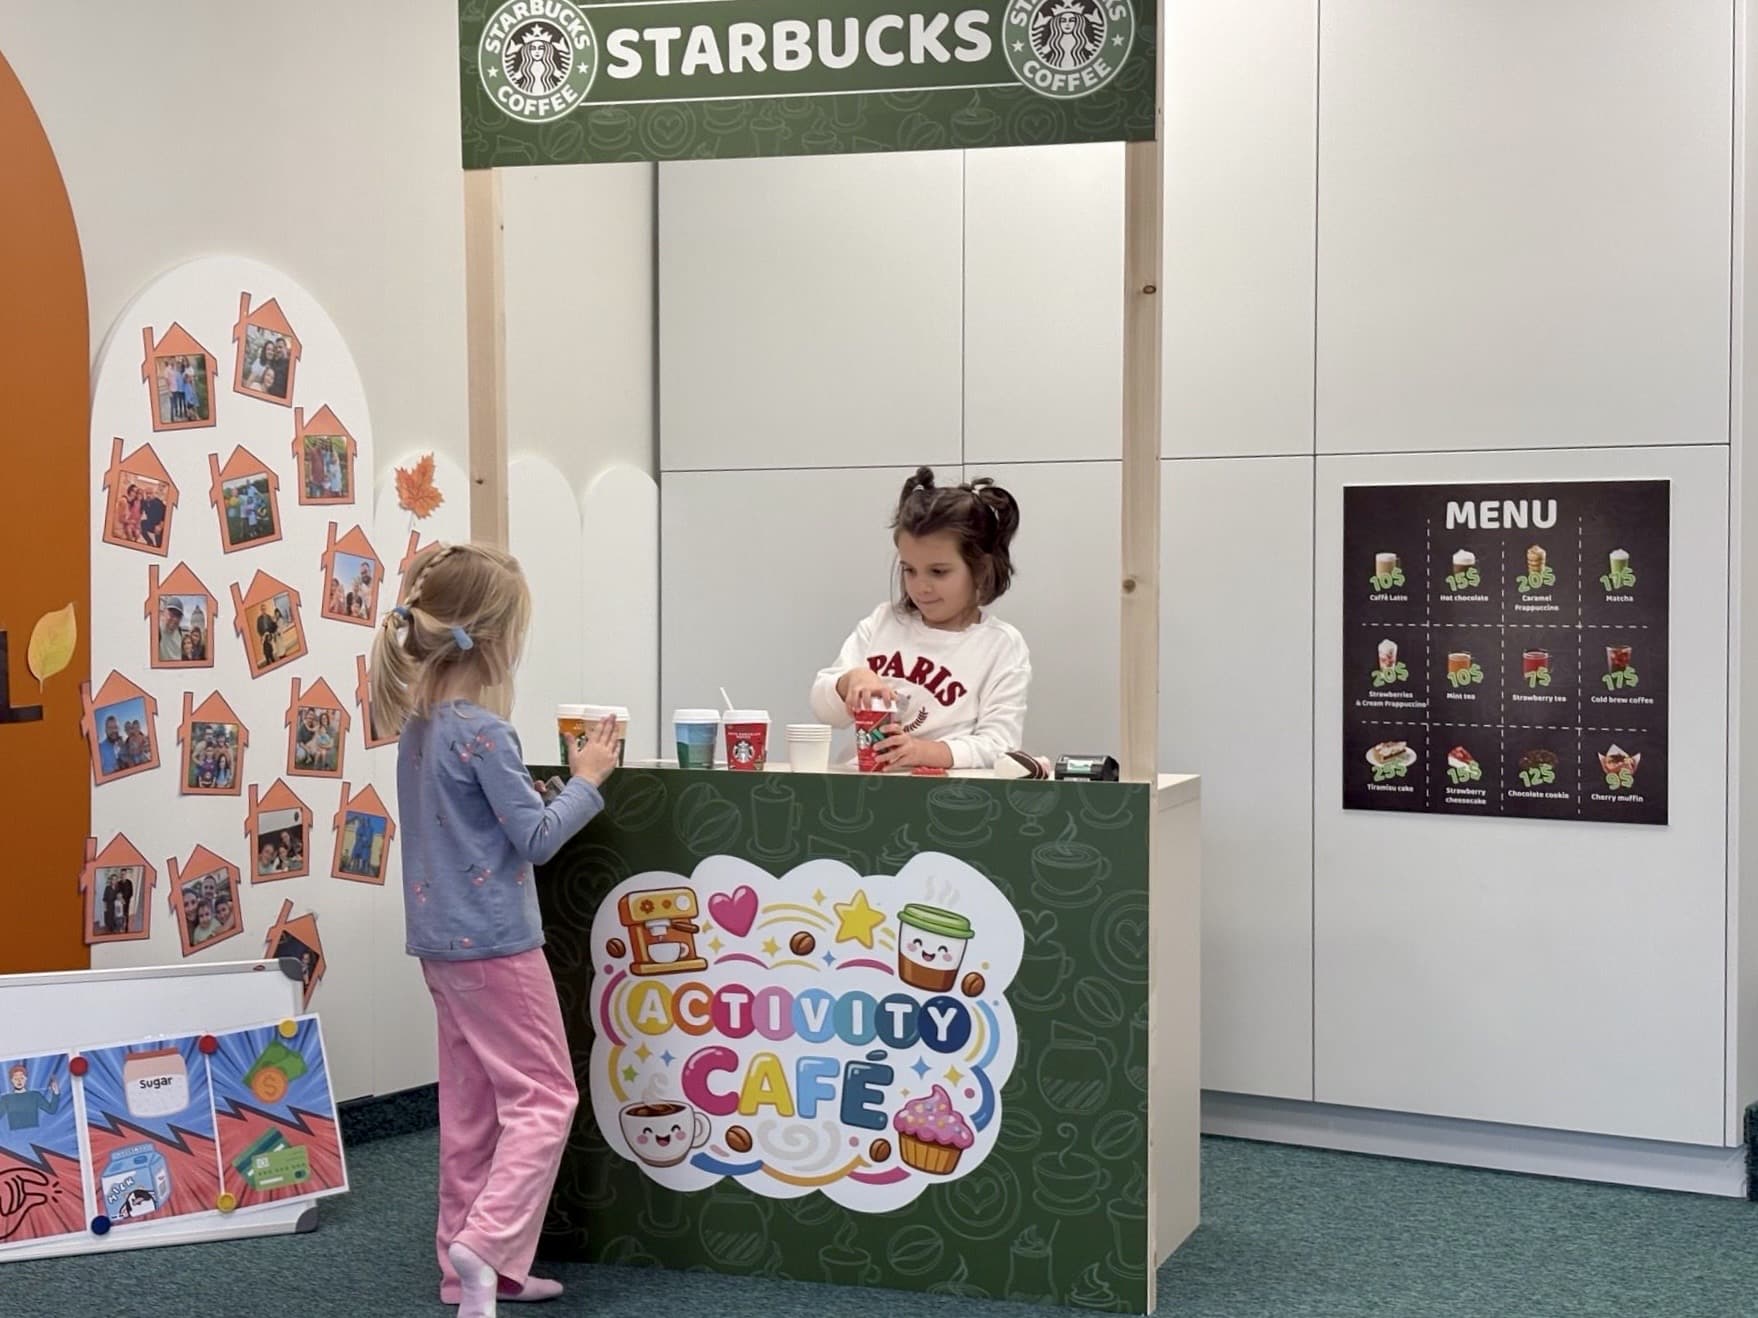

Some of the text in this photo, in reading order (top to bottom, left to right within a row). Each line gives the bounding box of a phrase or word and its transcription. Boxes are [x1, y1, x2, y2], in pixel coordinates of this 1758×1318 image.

[485, 0, 591, 54] STARBUCKS
[606, 10, 993, 80] STARBUCKS
[1023, 57, 1112, 92] COFFEE
[497, 84, 578, 116] COFFEE
[1445, 499, 1557, 530] MENU
[1370, 566, 1406, 592] 10$
[1446, 567, 1481, 592] 15$
[1516, 566, 1556, 592] 20$
[1389, 594, 1408, 602] Latte
[1440, 594, 1489, 602] Hot chocolate
[1515, 604, 1559, 612] Frappuccino
[1522, 594, 1552, 602] Caramel
[1606, 594, 1634, 602] Matcha
[867, 650, 967, 707] PARIS
[1371, 661, 1409, 687] 20$
[1447, 663, 1484, 688] 10$
[1526, 666, 1552, 688] 7$
[1602, 666, 1639, 691] 17$
[1362, 699, 1384, 707] Cream
[1385, 700, 1427, 709] Frappuccino
[1369, 690, 1413, 699] Strawberries
[1446, 692, 1463, 700] Mint
[1512, 694, 1553, 703] Strawberry
[1591, 695, 1654, 704] Cold brew coffee
[1447, 760, 1482, 784] 15$
[1519, 763, 1555, 787] 12$
[1605, 768, 1634, 790] 9$
[1367, 783, 1414, 793] Tiramisu cake
[1446, 787, 1486, 796] Strawberry
[1508, 790, 1569, 799] Chocolate cookie
[1591, 793, 1644, 803] Cherry muffin
[1445, 797, 1487, 805] cheesecake
[636, 985, 960, 1043] ACTIVITY
[140, 1075, 173, 1090] Sugar
[681, 1046, 895, 1131] CAFÉ
[108, 1176, 135, 1205] MILK
